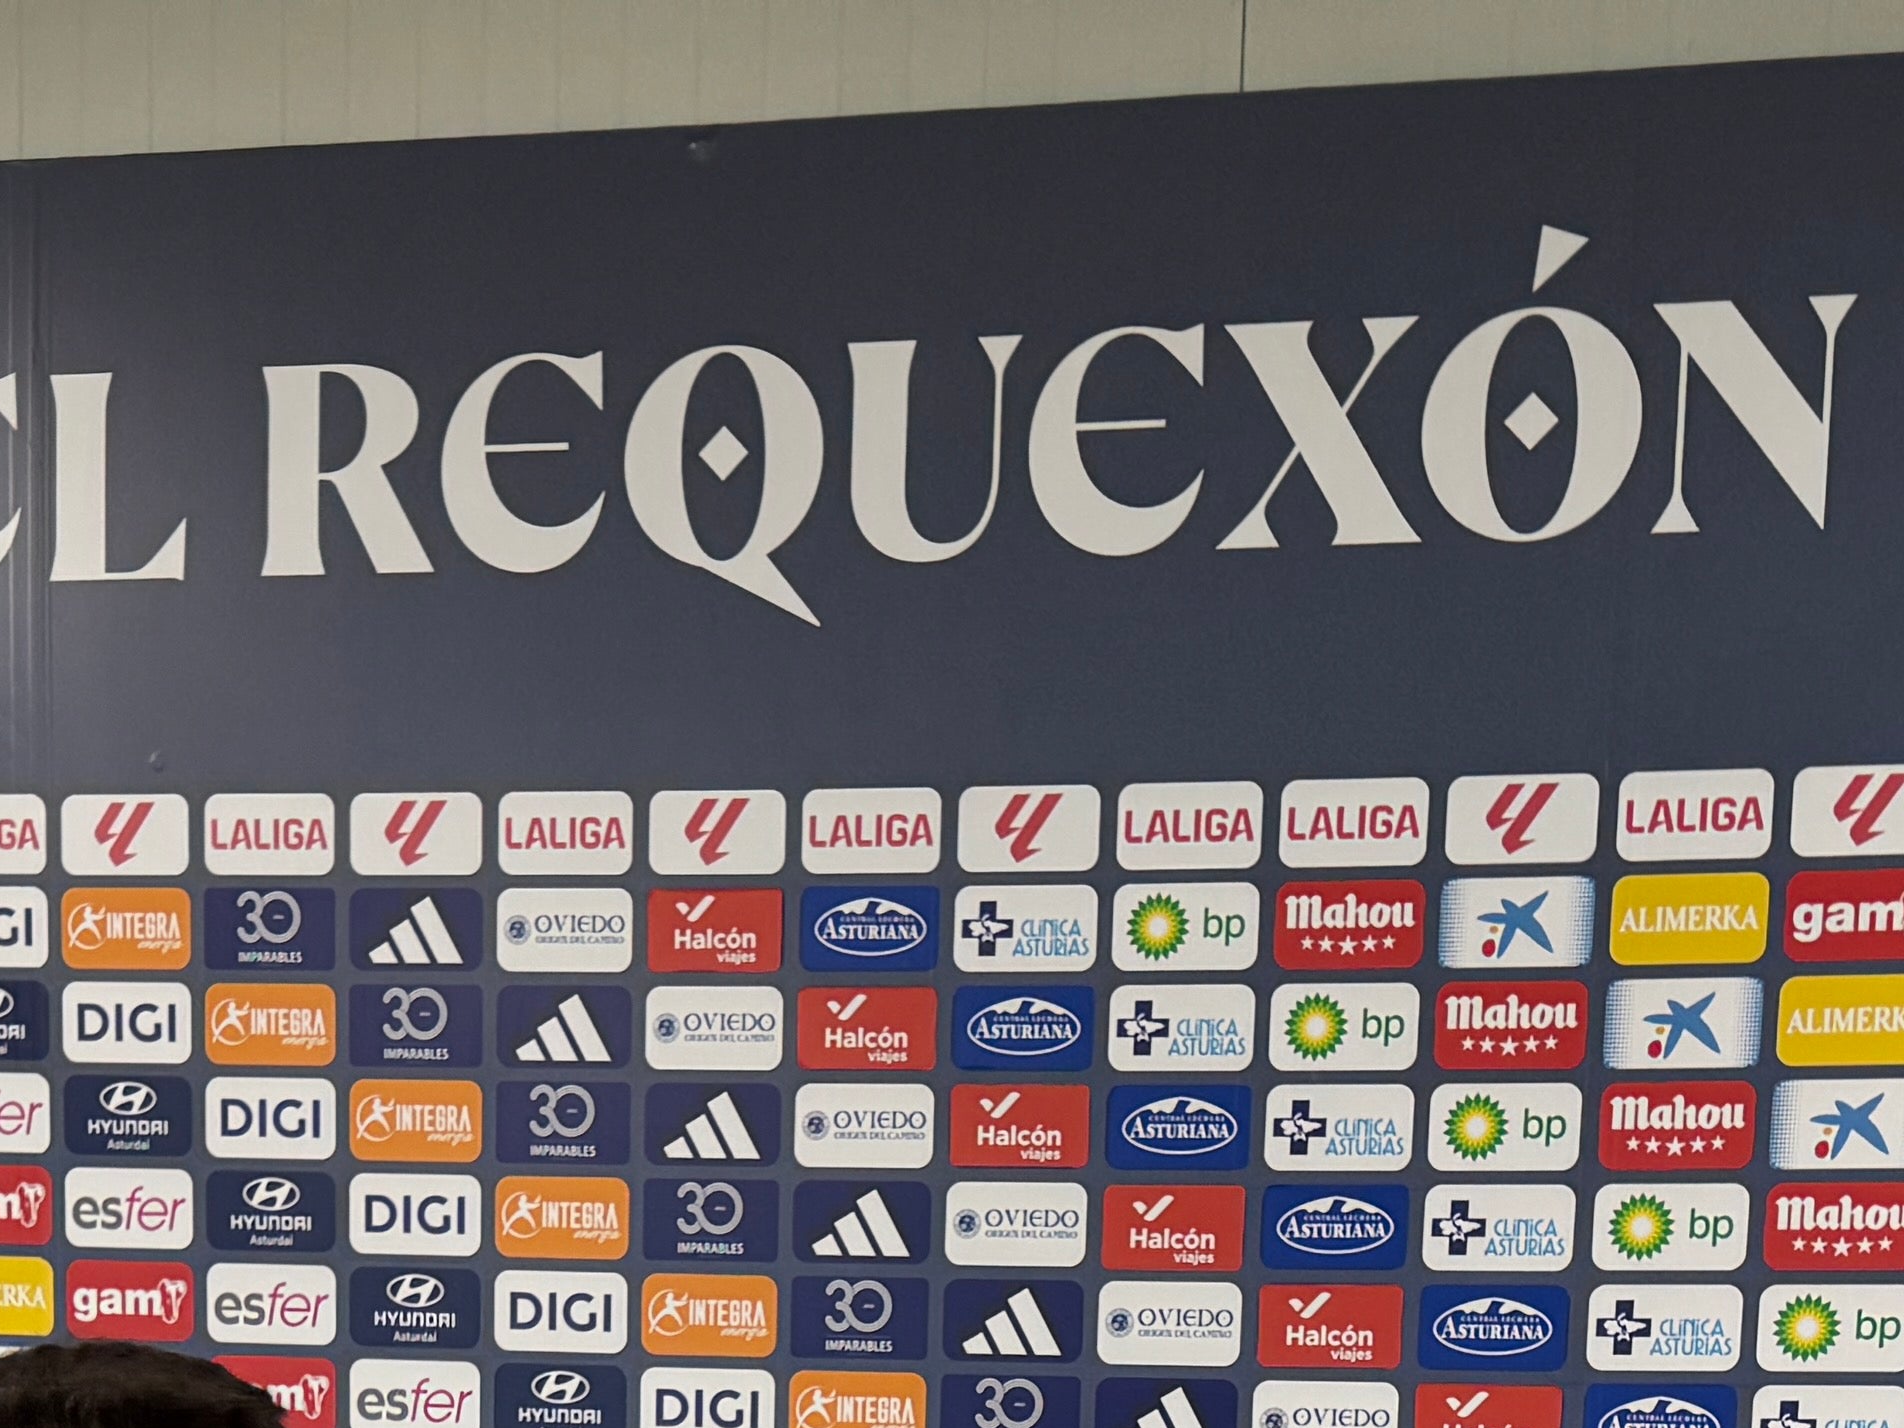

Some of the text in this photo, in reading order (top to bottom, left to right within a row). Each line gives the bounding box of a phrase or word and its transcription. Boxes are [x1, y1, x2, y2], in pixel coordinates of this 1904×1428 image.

[260, 225, 1859, 626] REQUEXÓN
[504, 817, 625, 849] LALIGA
[1625, 797, 1765, 834] LALIGA
[210, 819, 327, 850] LALIGA
[822, 918, 919, 940] ASTURIANA
[1203, 907, 1245, 946] bp
[1285, 894, 1415, 929] Mahou
[1621, 907, 1756, 931] ALIMERKA
[382, 987, 448, 1040] 30
[383, 1048, 449, 1060] IMPARABLES
[221, 1099, 320, 1138] DIGI
[73, 1186, 185, 1231] esfer
